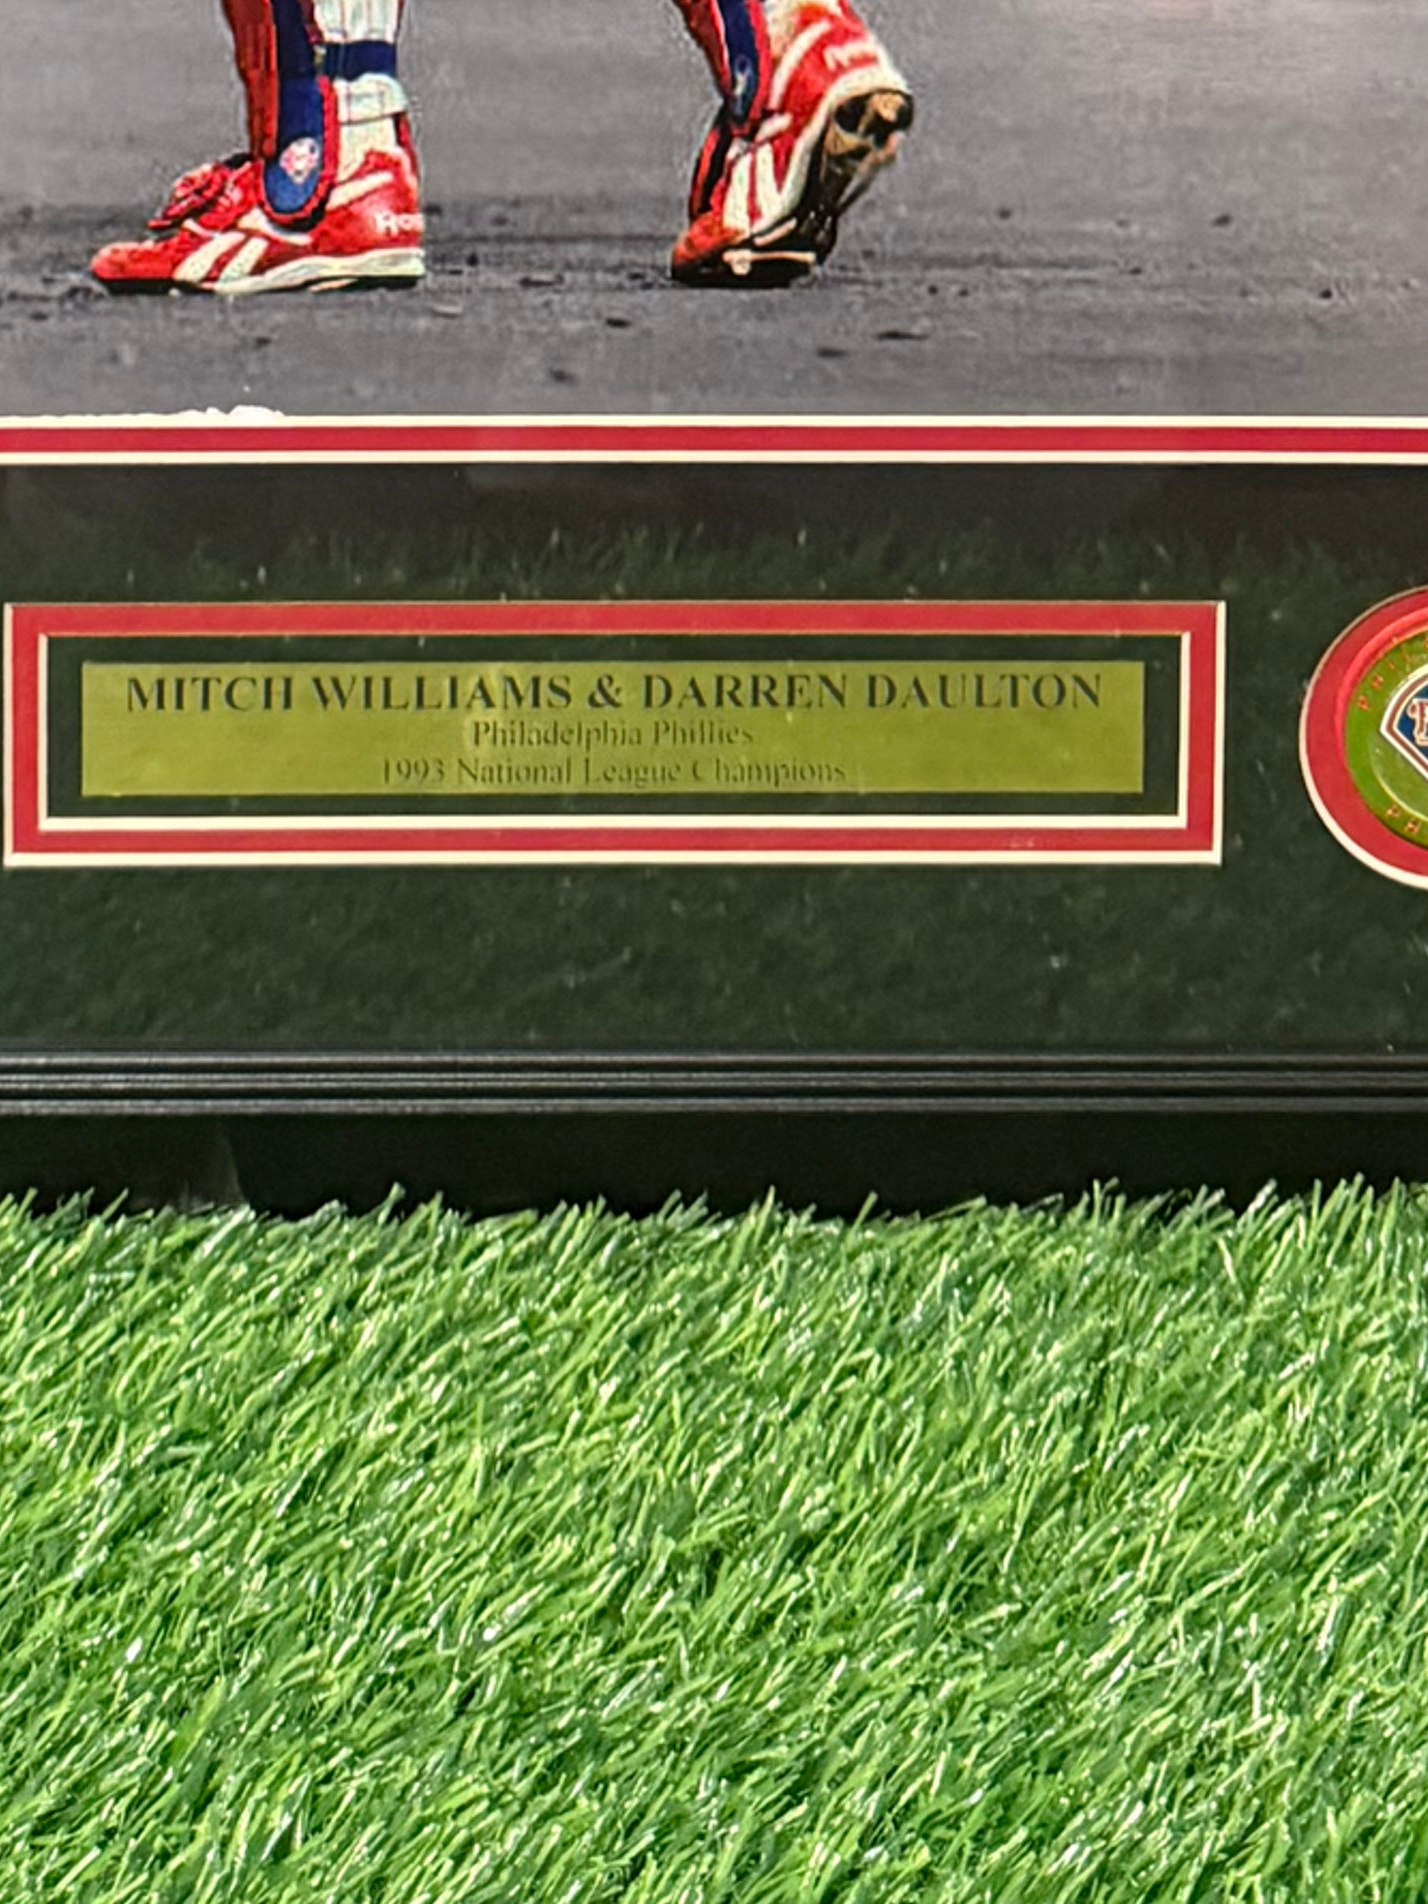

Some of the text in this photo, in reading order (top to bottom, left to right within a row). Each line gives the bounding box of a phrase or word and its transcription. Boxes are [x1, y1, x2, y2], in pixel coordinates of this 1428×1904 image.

[126, 673, 1101, 713] MITCH WILLIAMS & DARREN DAULTON
[473, 719, 754, 753] Philadelphia Phillies
[383, 755, 847, 789] 1993 National League Champions
